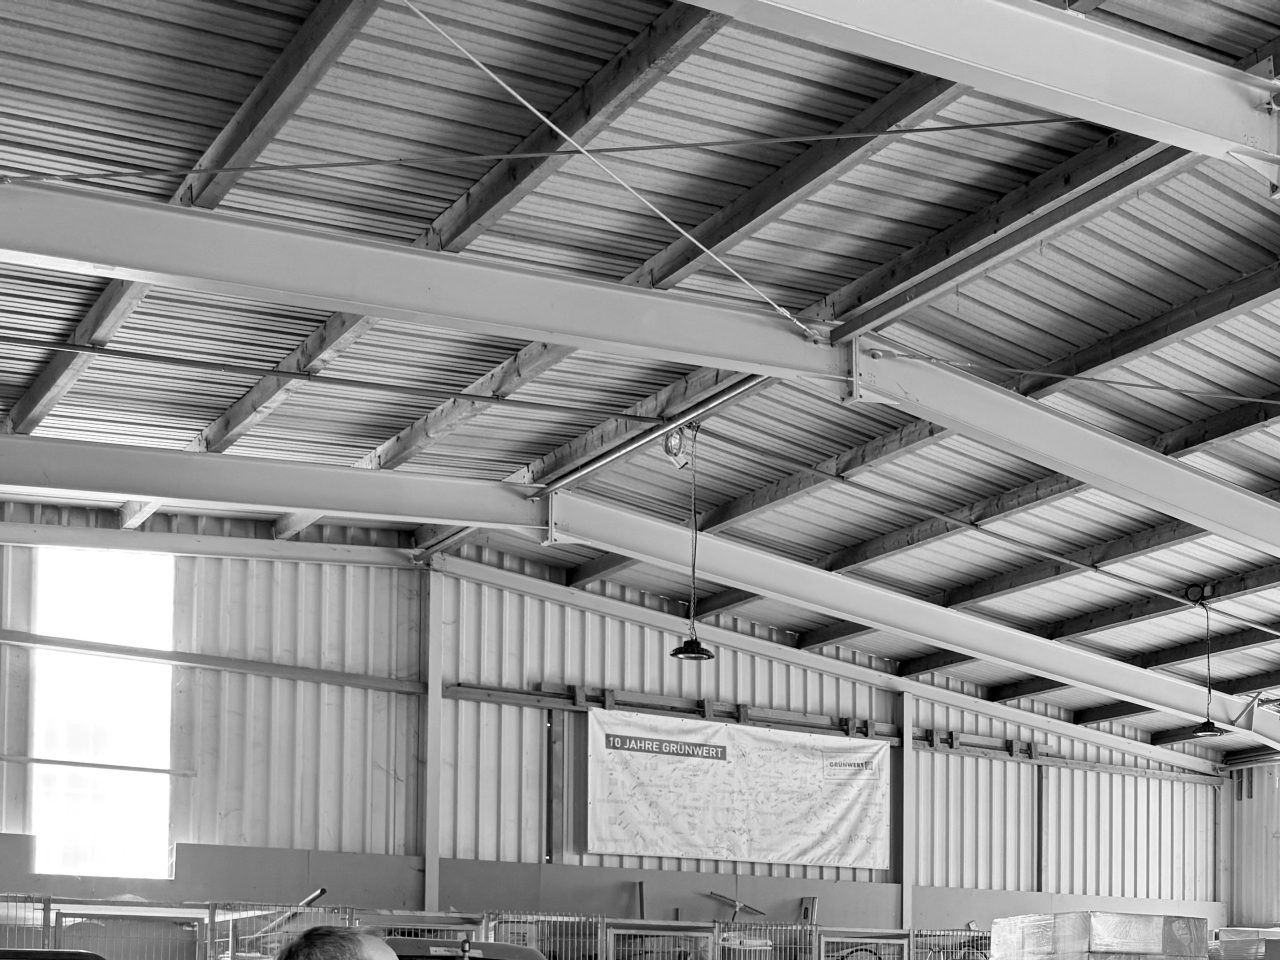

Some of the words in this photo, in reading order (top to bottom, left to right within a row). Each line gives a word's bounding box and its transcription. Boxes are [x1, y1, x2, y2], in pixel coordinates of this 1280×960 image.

[609, 737, 621, 747] 10
[624, 739, 660, 752] JAHRE
[662, 742, 723, 758] GRÜNWERT
